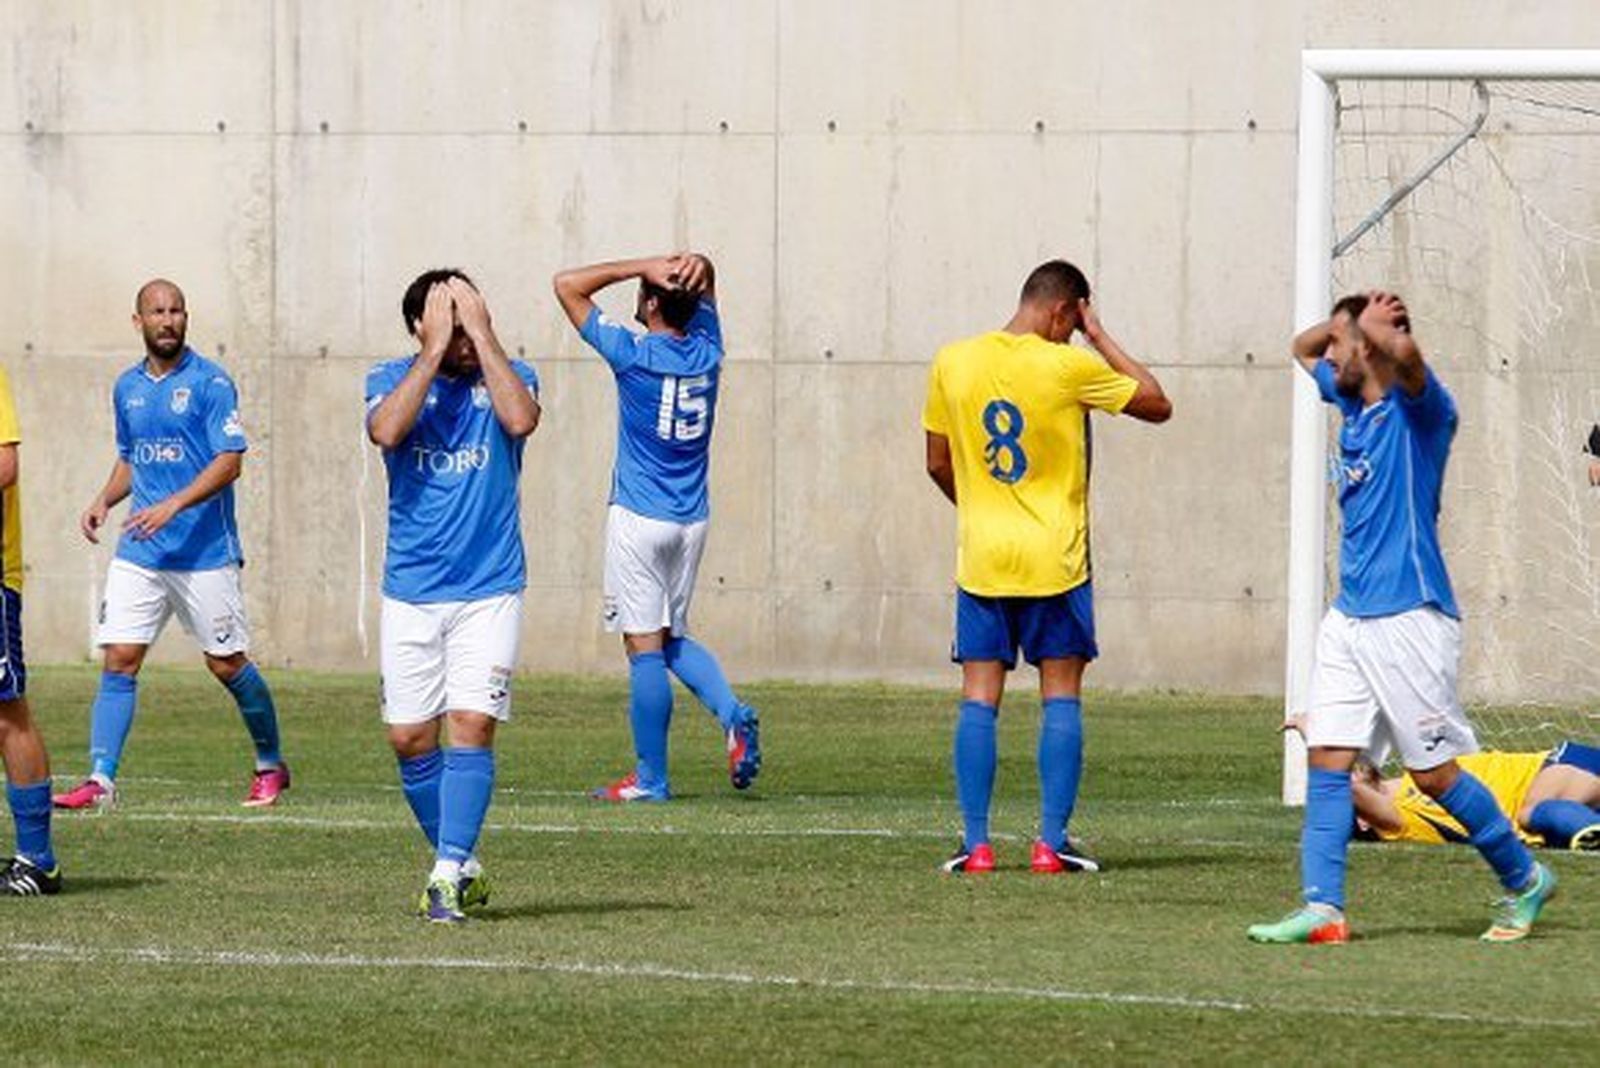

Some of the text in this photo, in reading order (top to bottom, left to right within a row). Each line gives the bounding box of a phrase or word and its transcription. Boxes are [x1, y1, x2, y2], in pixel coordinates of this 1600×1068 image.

[657, 375, 709, 440] 15
[412, 445, 490, 474] TORO
[983, 398, 1028, 485] 8
